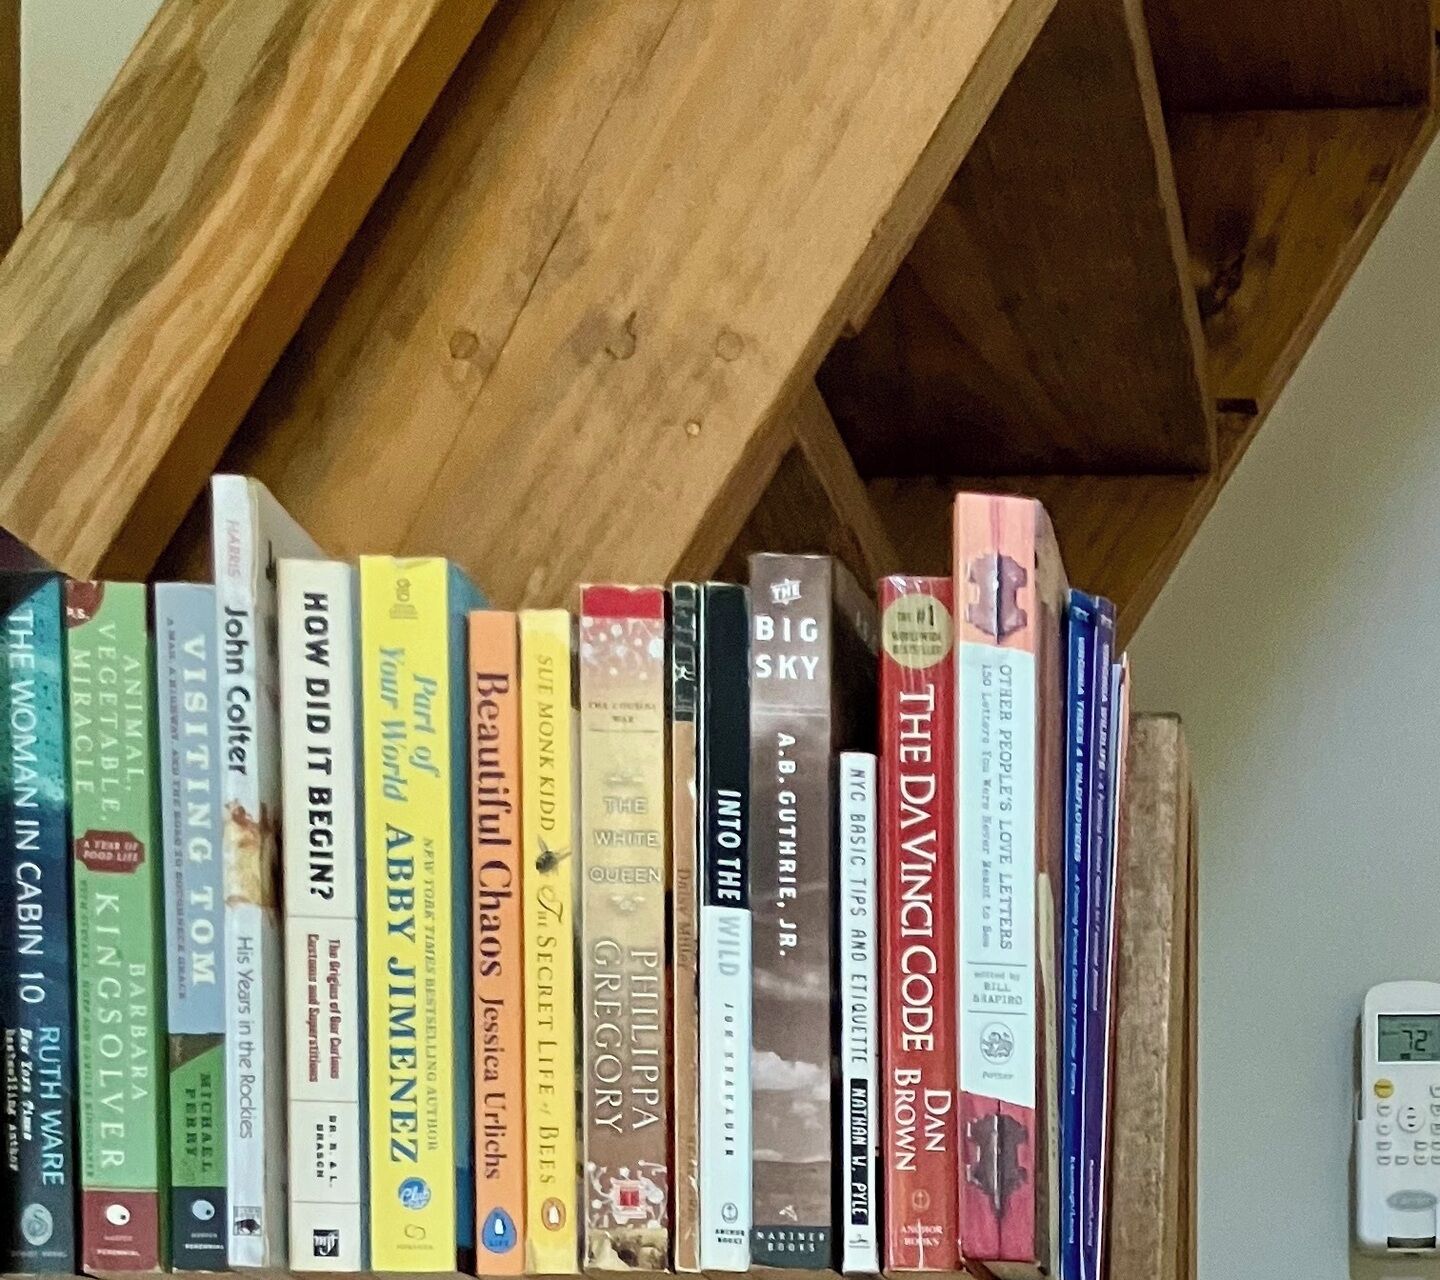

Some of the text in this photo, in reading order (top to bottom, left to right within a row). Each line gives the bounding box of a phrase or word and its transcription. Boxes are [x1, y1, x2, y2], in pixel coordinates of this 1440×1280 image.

[756, 614, 818, 642] BIG
[772, 582, 800, 602] THE
[71, 651, 95, 794] MIRACLE
[98, 623, 121, 822] VEGETABLE,
[122, 654, 146, 791] ANIMAL,
[225, 605, 252, 776] John Colter
[379, 646, 408, 802] Your World
[409, 673, 441, 778] Part of
[537, 654, 556, 831] SUE MONK KIDD
[755, 655, 819, 681] SKY
[8, 609, 46, 1004] THE WOMAN IN CABIN 10
[184, 634, 216, 986] VISITING TOM
[304, 591, 335, 900] HOW DID IT BEGIN?
[603, 797, 648, 814] THE
[1000, 664, 1013, 950] OTHER PEOPLE'S LOVE LETTERS
[476, 672, 512, 978] Beautiful Chaos
[589, 866, 662, 884] QUEEN
[593, 830, 660, 848] WHITE
[717, 789, 741, 977] INTO THE WILD
[777, 791, 798, 909] GUTHRIE,
[900, 683, 937, 1052] THE DA VINCI CODE
[779, 919, 797, 957] JR.
[849, 768, 868, 1064] NYC BASIC TIPS AND ETIQUETTE
[95, 892, 125, 1168] KINGSOLVER
[128, 963, 149, 1101] BARBARA
[237, 937, 255, 1139] His Years in the Rockies
[386, 822, 418, 1164] ABBY JIMENEZ
[594, 940, 623, 1134] GREGORY
[631, 950, 660, 1130] PHILIPPA
[1402, 1030, 1428, 1051] 72
[185, 1088, 199, 1158] PERRY
[200, 1072, 214, 1173] MICHAEL
[479, 996, 508, 1180] Jessica Urlichs
[894, 1067, 922, 1172] BROWN
[923, 1088, 951, 1152] DAN
[767, 1242, 816, 1252] BOOKS
